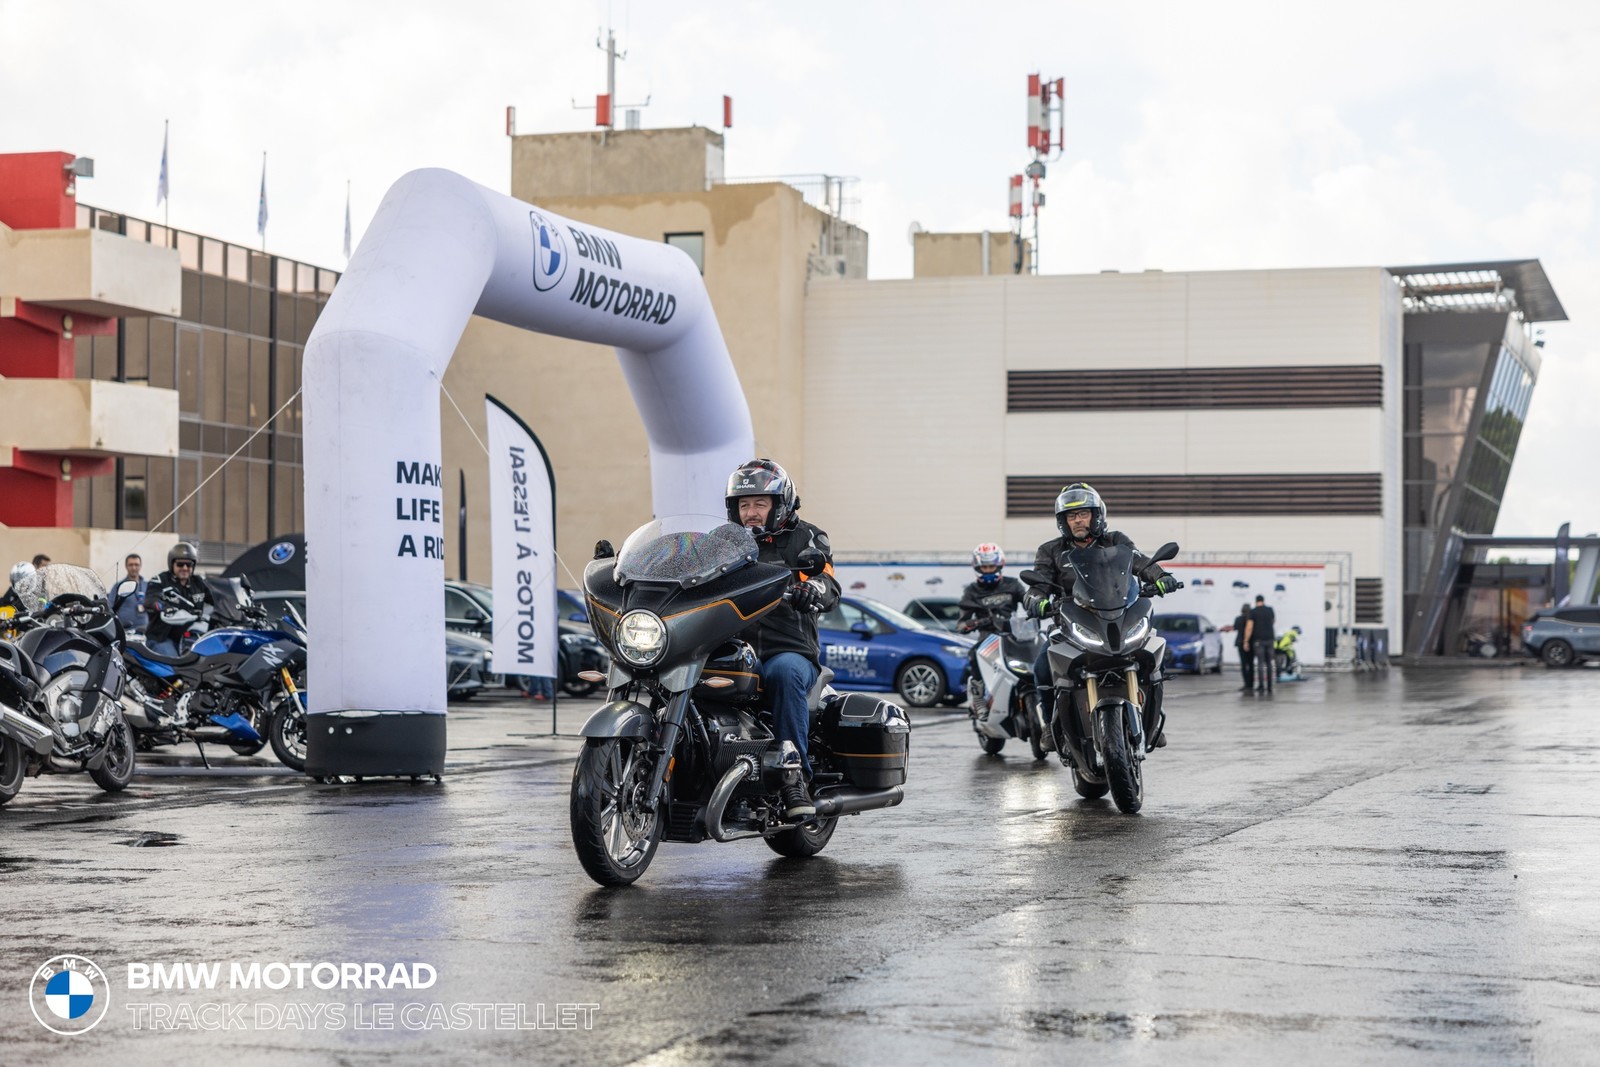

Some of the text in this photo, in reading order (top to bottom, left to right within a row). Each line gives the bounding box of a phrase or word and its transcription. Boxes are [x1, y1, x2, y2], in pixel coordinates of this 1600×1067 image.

[567, 225, 622, 270] BMW
[569, 267, 676, 325] MOTORRAD
[396, 461, 442, 488] MAK
[396, 498, 440, 523] LIFE
[397, 534, 418, 557] A
[826, 645, 869, 661] BMW
